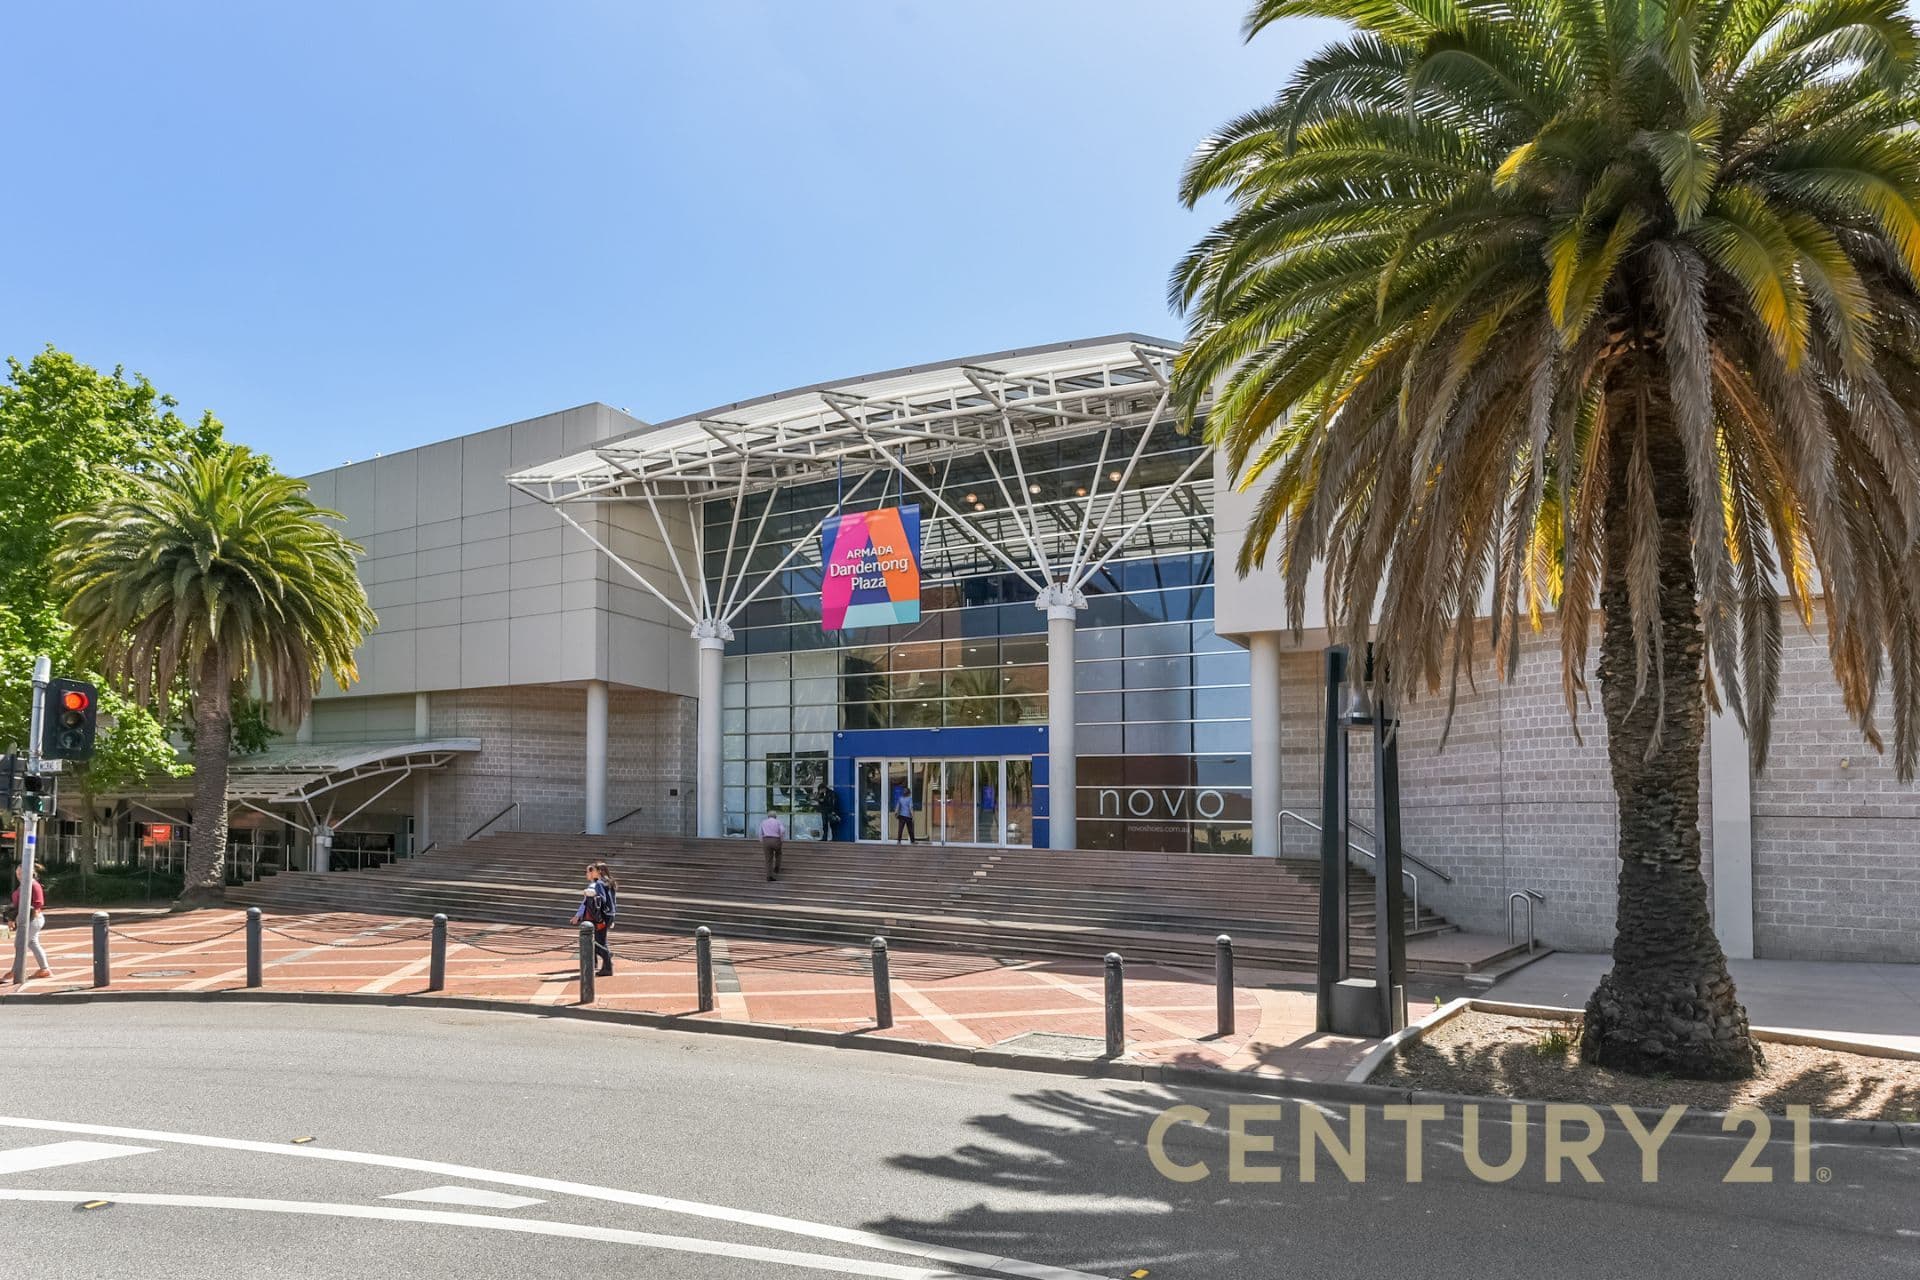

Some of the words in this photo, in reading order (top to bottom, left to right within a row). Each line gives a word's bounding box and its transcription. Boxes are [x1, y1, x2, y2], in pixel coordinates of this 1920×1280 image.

[847, 545, 894, 559] ARMADA
[830, 558, 908, 577] Dandenong
[851, 576, 887, 591] Plaza
[1099, 789, 1225, 818] novo
